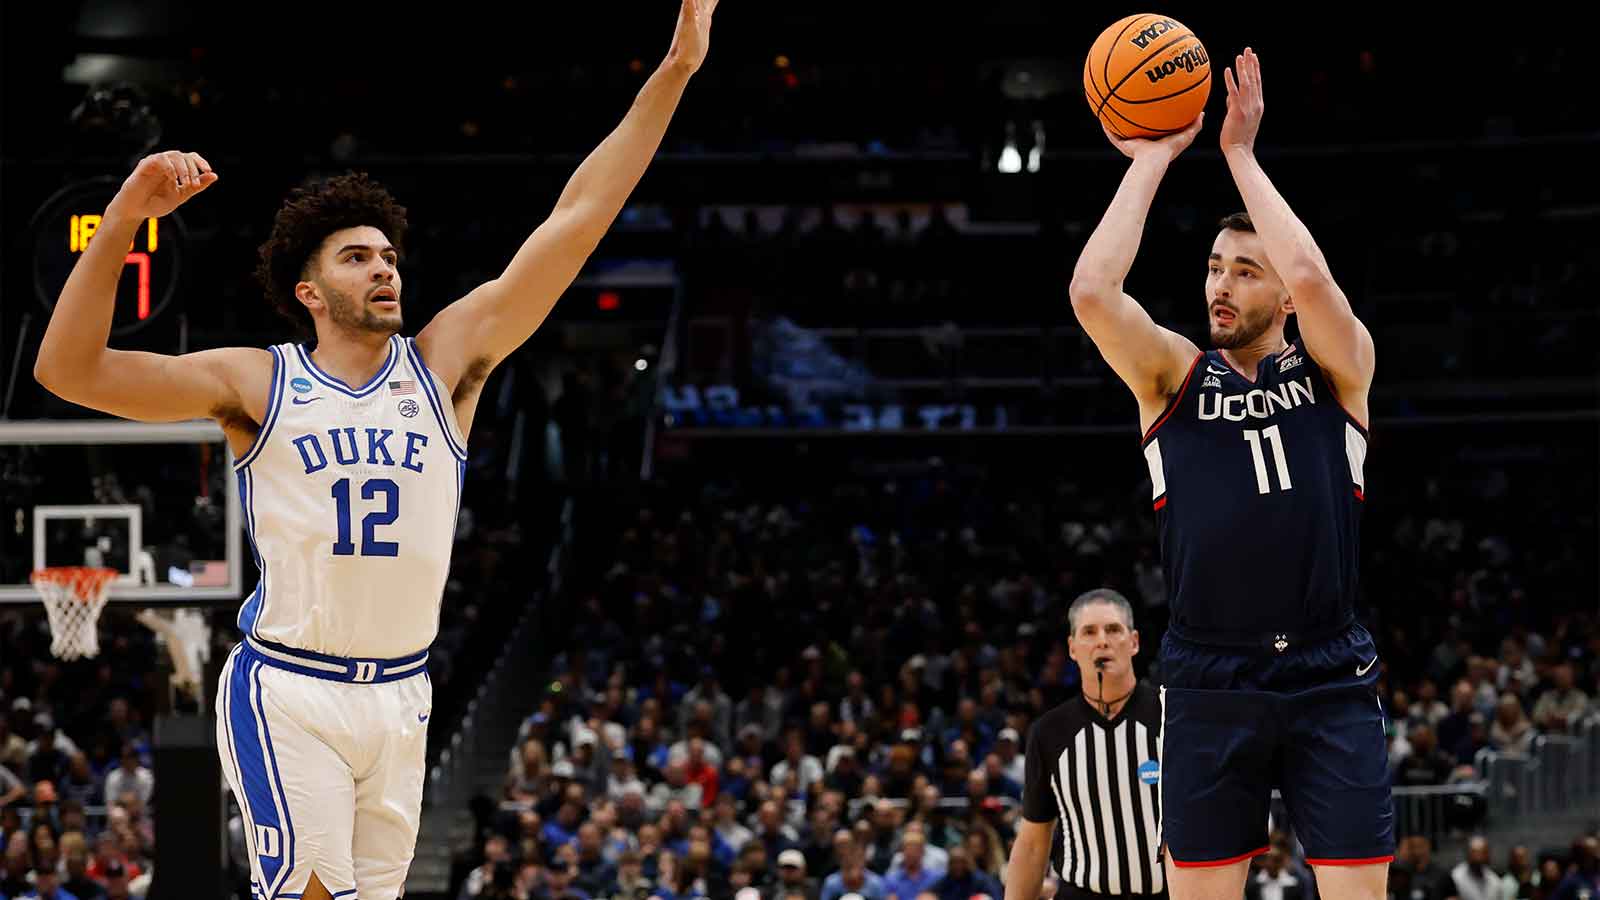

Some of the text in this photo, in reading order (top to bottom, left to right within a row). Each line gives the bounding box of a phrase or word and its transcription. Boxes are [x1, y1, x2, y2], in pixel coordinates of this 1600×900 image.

[1131, 19, 1178, 49] NCAA
[1145, 43, 1209, 83] Wilson
[1198, 377, 1315, 421] UCONN
[291, 427, 429, 475] DUKE
[1243, 424, 1293, 494] 11
[331, 478, 399, 557] 12
[352, 661, 377, 682] D
[255, 824, 279, 858] D
